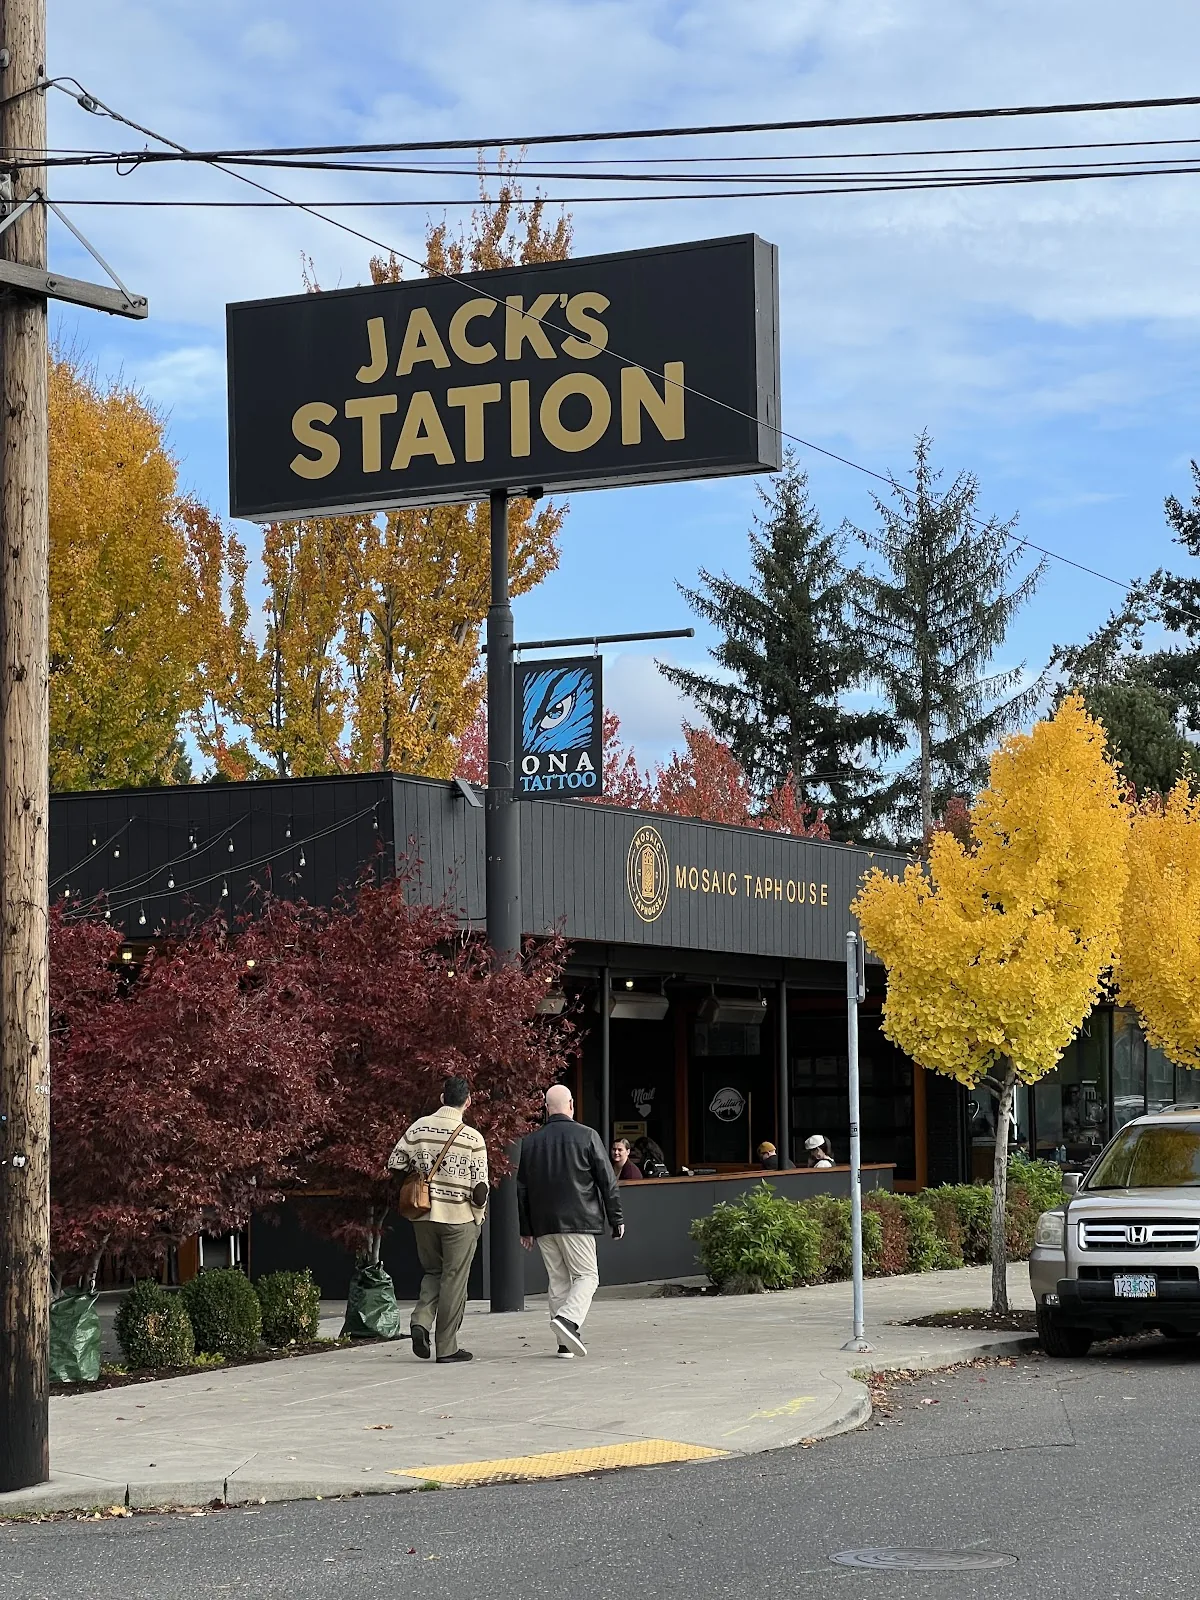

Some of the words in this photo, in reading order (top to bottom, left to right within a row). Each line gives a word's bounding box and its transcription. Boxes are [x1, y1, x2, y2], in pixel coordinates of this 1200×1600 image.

[355, 291, 611, 384] JACK'S
[290, 361, 686, 480] STATION
[520, 771, 597, 792] TATTOO
[635, 831, 661, 852] MOSAIC
[675, 864, 738, 896] MOSAIC
[744, 874, 829, 906] TAPHOUSE
[633, 893, 663, 916] TAPHOUSE
[631, 1087, 656, 1104] Mail
